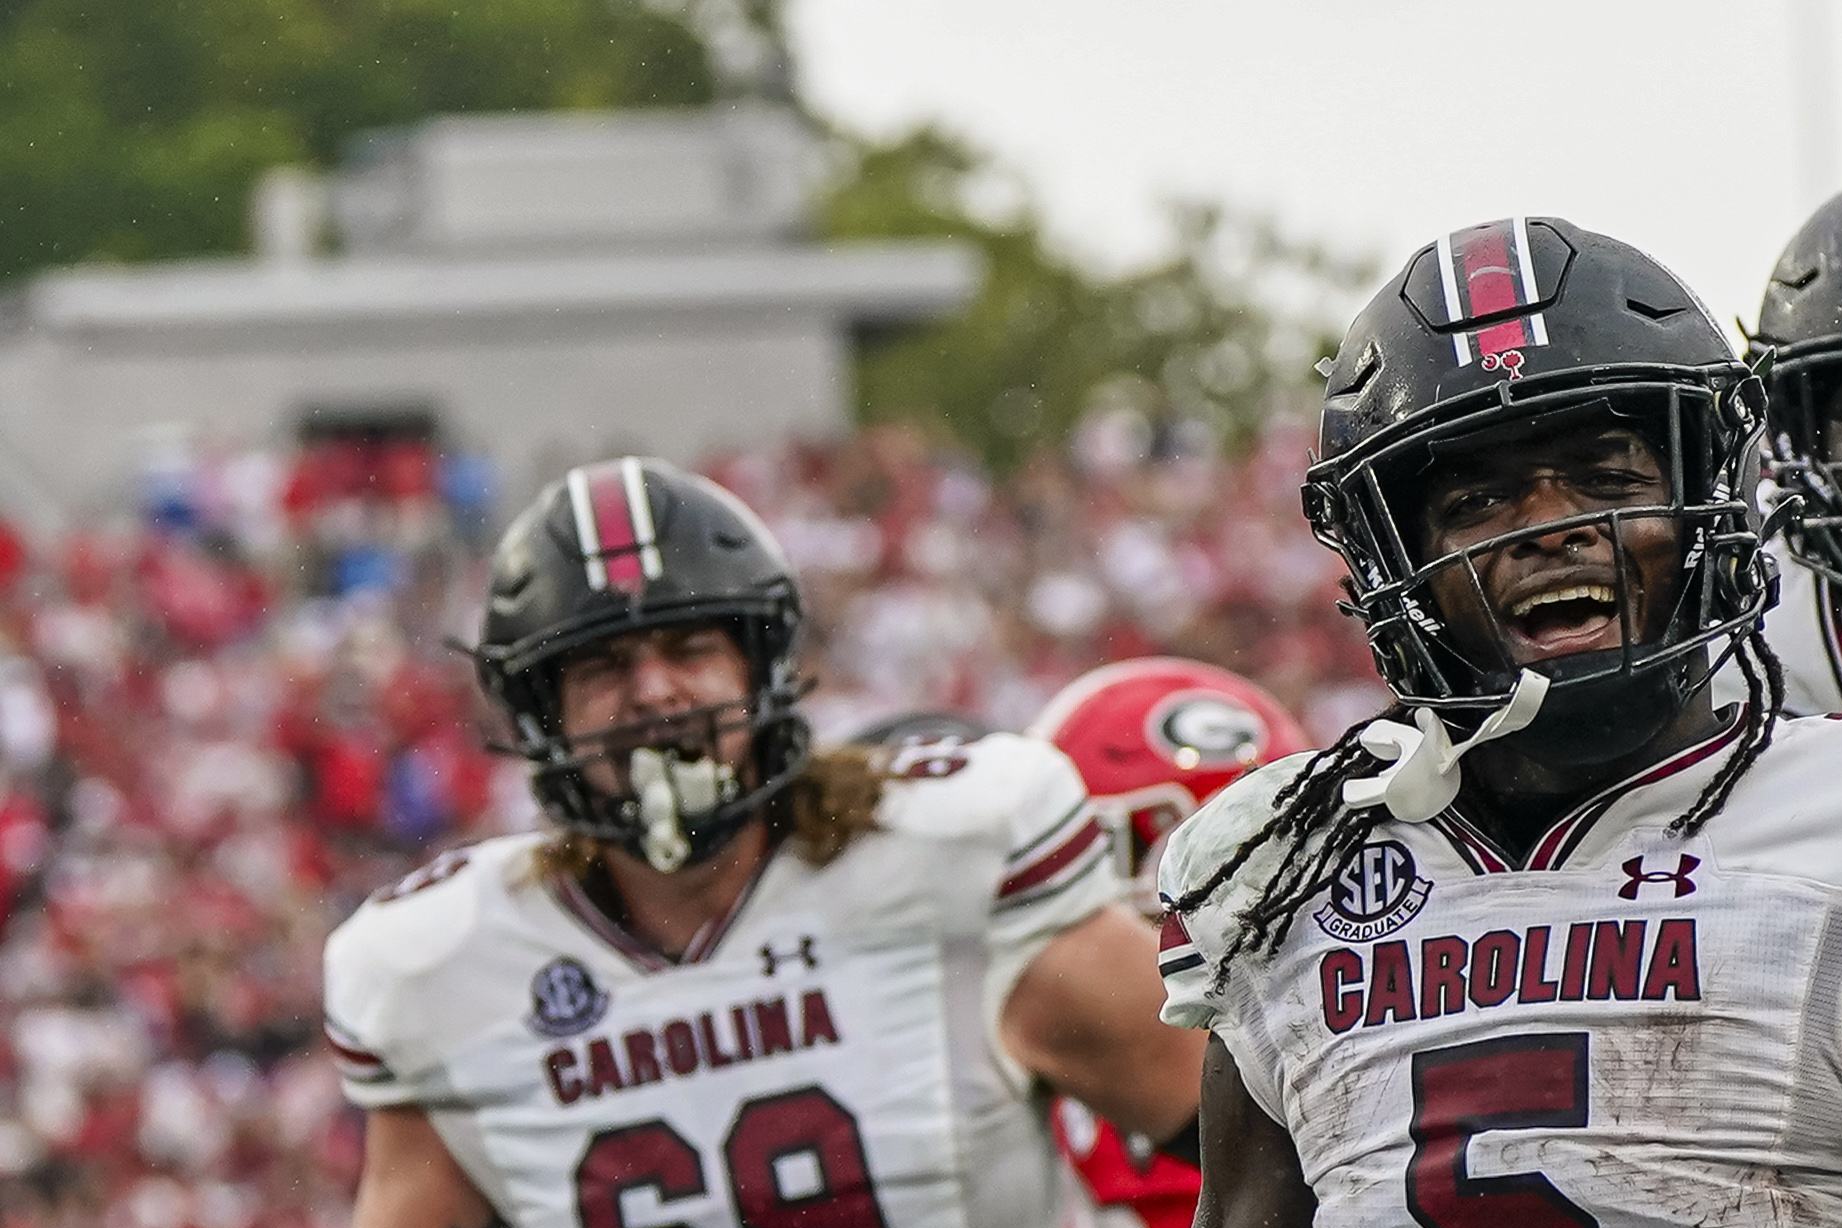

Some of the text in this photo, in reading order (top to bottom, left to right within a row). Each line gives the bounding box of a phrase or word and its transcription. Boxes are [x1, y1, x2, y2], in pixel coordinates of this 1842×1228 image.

[1328, 898, 1419, 940] GRADUATE
[1339, 846, 1405, 915] SEC
[1319, 917, 1702, 1033] CAROLINA
[543, 989, 840, 1106] CAROLINA
